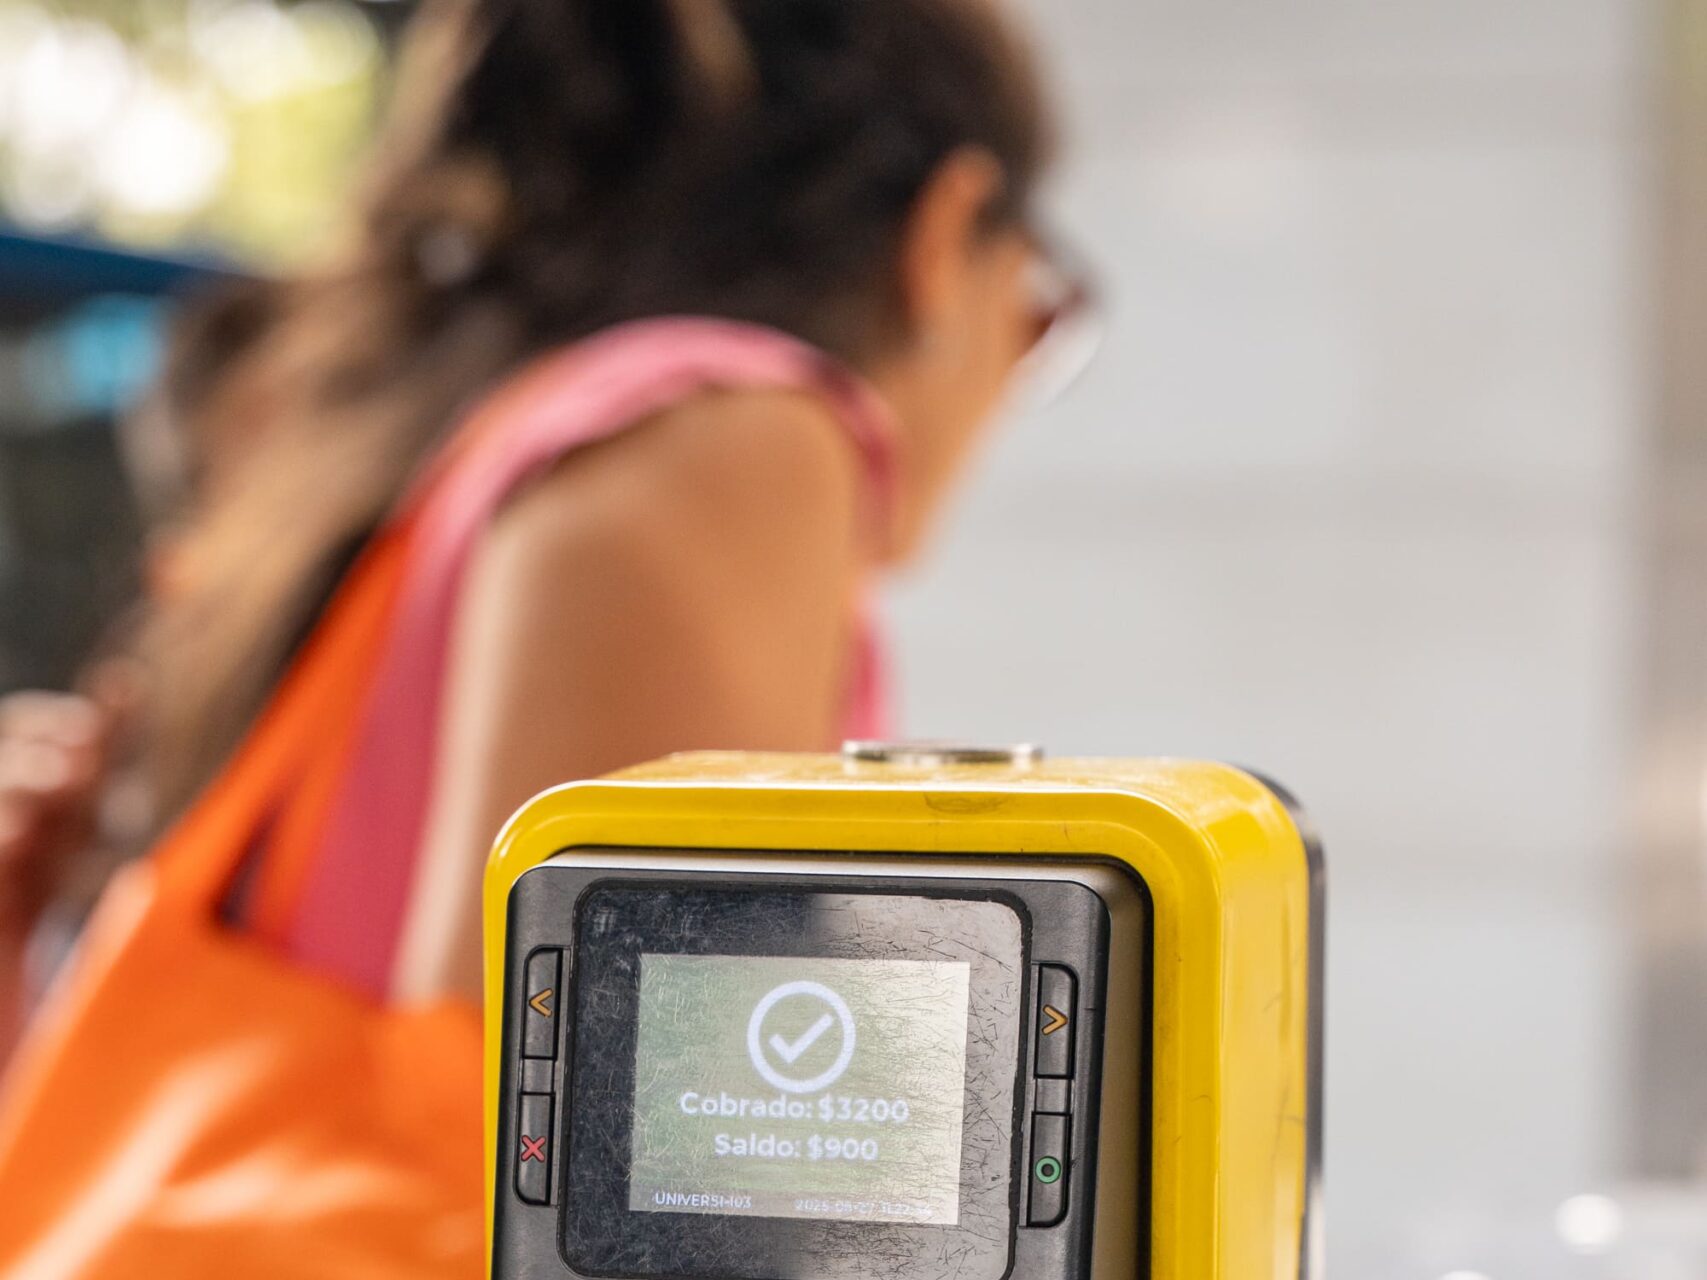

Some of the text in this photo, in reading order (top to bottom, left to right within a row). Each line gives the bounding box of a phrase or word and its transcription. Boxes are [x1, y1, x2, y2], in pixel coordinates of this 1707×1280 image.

[680, 1090, 910, 1124] Cobrado: $3200
[713, 1132, 879, 1163] Saldo: $900
